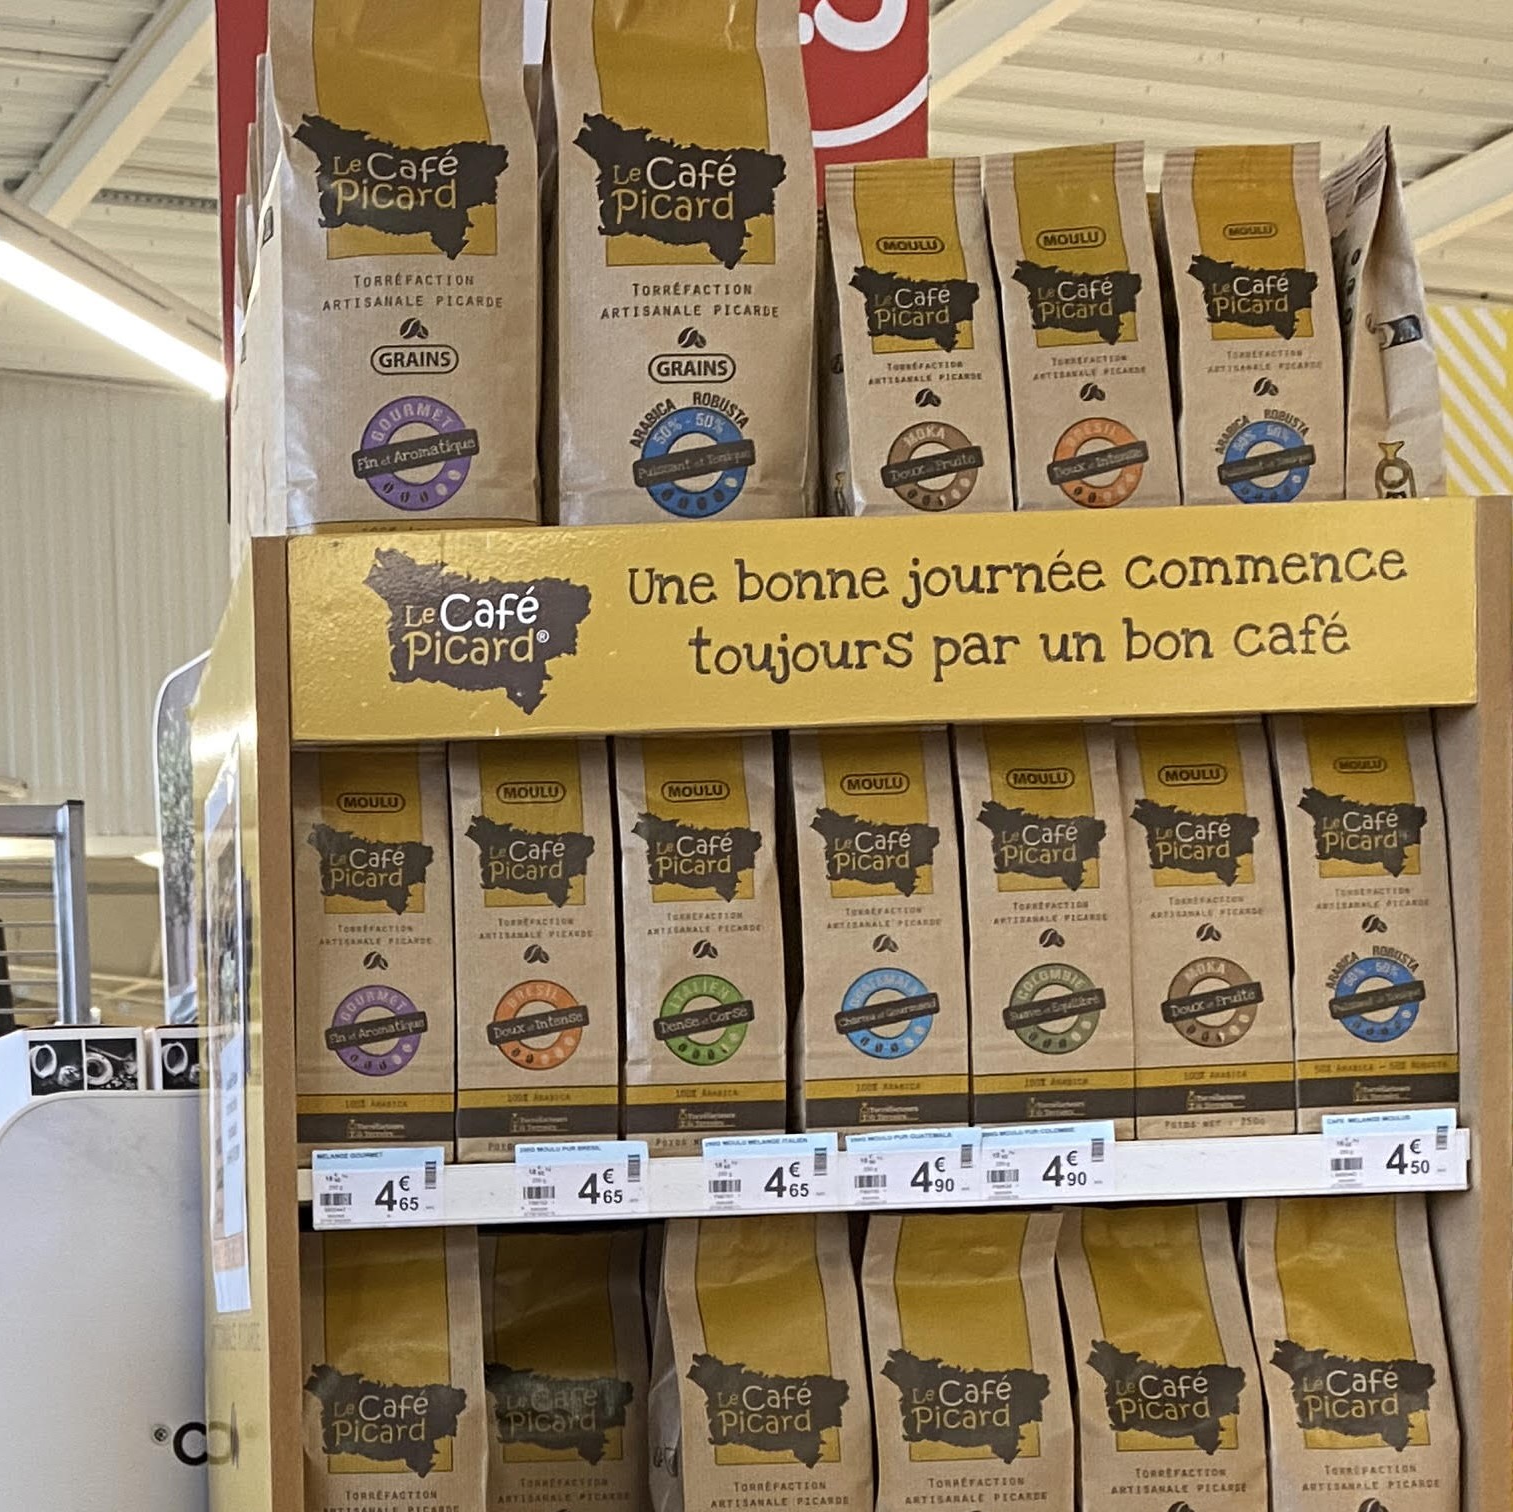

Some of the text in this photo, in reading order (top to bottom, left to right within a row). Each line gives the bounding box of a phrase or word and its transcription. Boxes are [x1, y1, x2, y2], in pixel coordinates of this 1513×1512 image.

[332, 151, 458, 182] Le Café
[612, 156, 736, 190] Le Café
[334, 179, 458, 215] Picard
[611, 189, 734, 223] Picard
[1043, 229, 1099, 247] MOULU
[1229, 224, 1272, 238] MOULU
[882, 237, 938, 252] MOULU
[894, 285, 951, 309] Café
[1057, 277, 1114, 301] Café
[1233, 275, 1290, 297] Café
[323, 295, 503, 311] ARTISANALE PICARDE
[600, 304, 779, 320] ARTISANALE PICARDE
[1040, 298, 1114, 322] Picard
[1213, 294, 1290, 318] Picard
[874, 307, 951, 329] Picard
[378, 349, 451, 371] GRAINS
[656, 358, 728, 379] GRAINS
[370, 402, 454, 443] GOURMET
[629, 391, 750, 448] ARABICA ROBUSTA
[357, 455, 379, 473] Fin
[393, 435, 476, 464] Aromatique
[627, 547, 1408, 609] Une bonne journée commence
[404, 584, 539, 633] Le Café
[688, 611, 1351, 684] toujours par un bon café
[1339, 760, 1382, 771] MOULU
[847, 777, 903, 791] MOULU
[1012, 772, 1068, 786] MOULU
[503, 786, 559, 800] MOULU
[668, 785, 723, 799] MOULU
[1343, 811, 1399, 831] Café
[855, 832, 911, 854] Café
[1022, 825, 1078, 846] Café
[1323, 830, 1399, 851] Picard
[509, 841, 565, 862] Café
[677, 837, 732, 859] Café
[1001, 843, 1077, 865] Picard
[489, 860, 563, 882] Picard
[656, 855, 731, 876] Picard
[833, 852, 910, 872] Picard
[1386, 1143, 1408, 1174] 4
[1411, 1160, 1430, 1174] 50
[764, 1167, 786, 1198] 4
[789, 1183, 809, 1197] 65
[910, 1161, 933, 1192] 4
[935, 1178, 954, 1192] 90
[1042, 1155, 1064, 1187] 4
[1067, 1172, 1086, 1186] 90
[375, 1180, 397, 1211] 4
[399, 1197, 419, 1211] 65
[578, 1173, 600, 1204] 4
[603, 1190, 623, 1204] 65
[938, 1374, 1012, 1406] Café
[1326, 1368, 1399, 1395] Café
[742, 1382, 812, 1410] Café
[1304, 1392, 1399, 1420] Picard
[718, 1410, 812, 1436] Picard
[912, 1405, 1010, 1432] Picard
